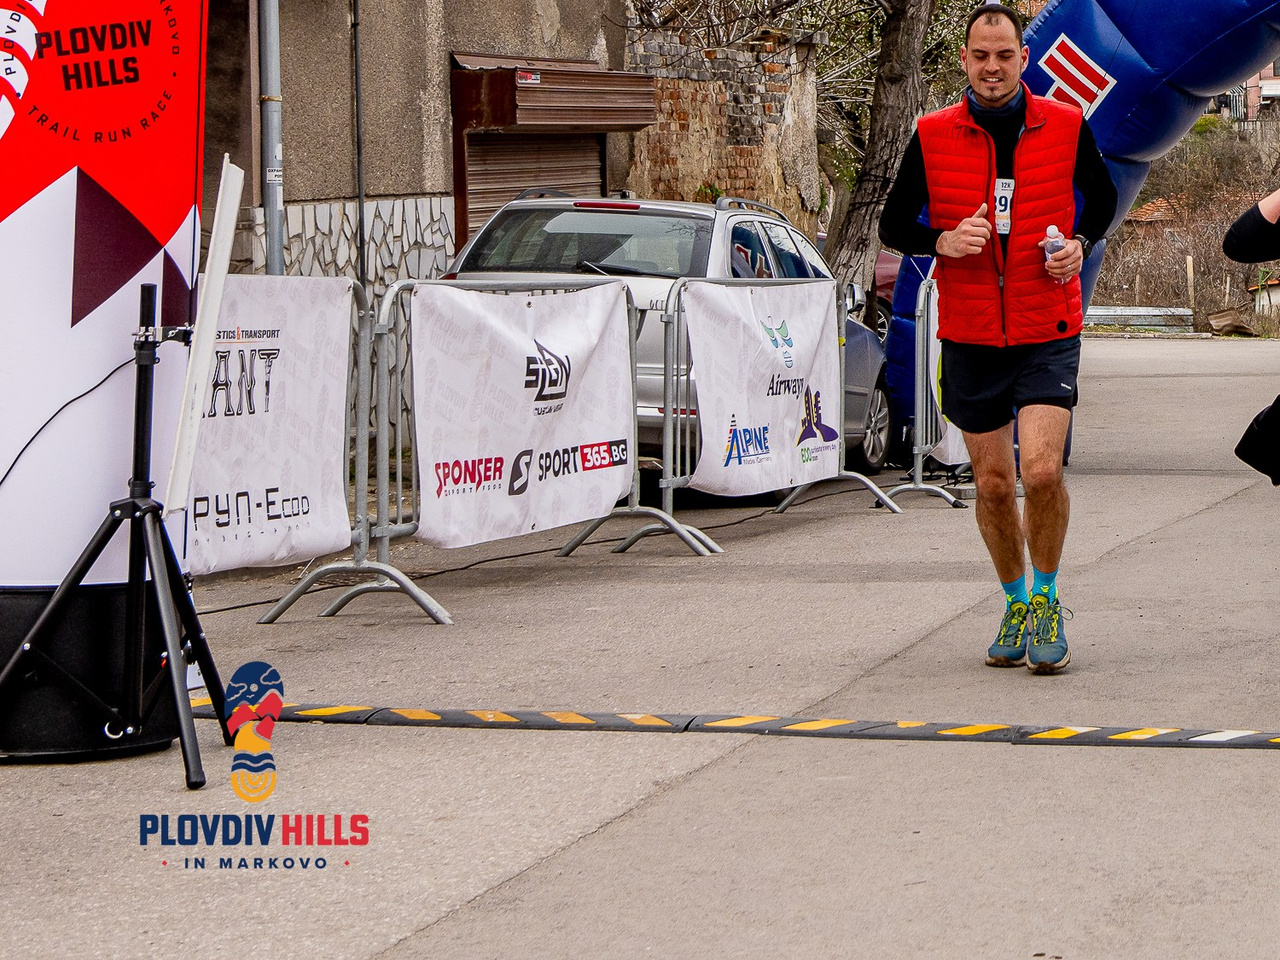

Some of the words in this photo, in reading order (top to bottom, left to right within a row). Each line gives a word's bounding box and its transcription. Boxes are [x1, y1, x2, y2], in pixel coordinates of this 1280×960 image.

[34, 19, 152, 60] PLOVDIV
[61, 56, 140, 92] HILLS
[27, 104, 81, 142] TRAIL
[94, 127, 133, 143] RUN
[139, 90, 172, 131] RACE
[994, 195, 1009, 212] 9
[202, 348, 280, 418] ANT
[434, 456, 505, 499] SPONSER
